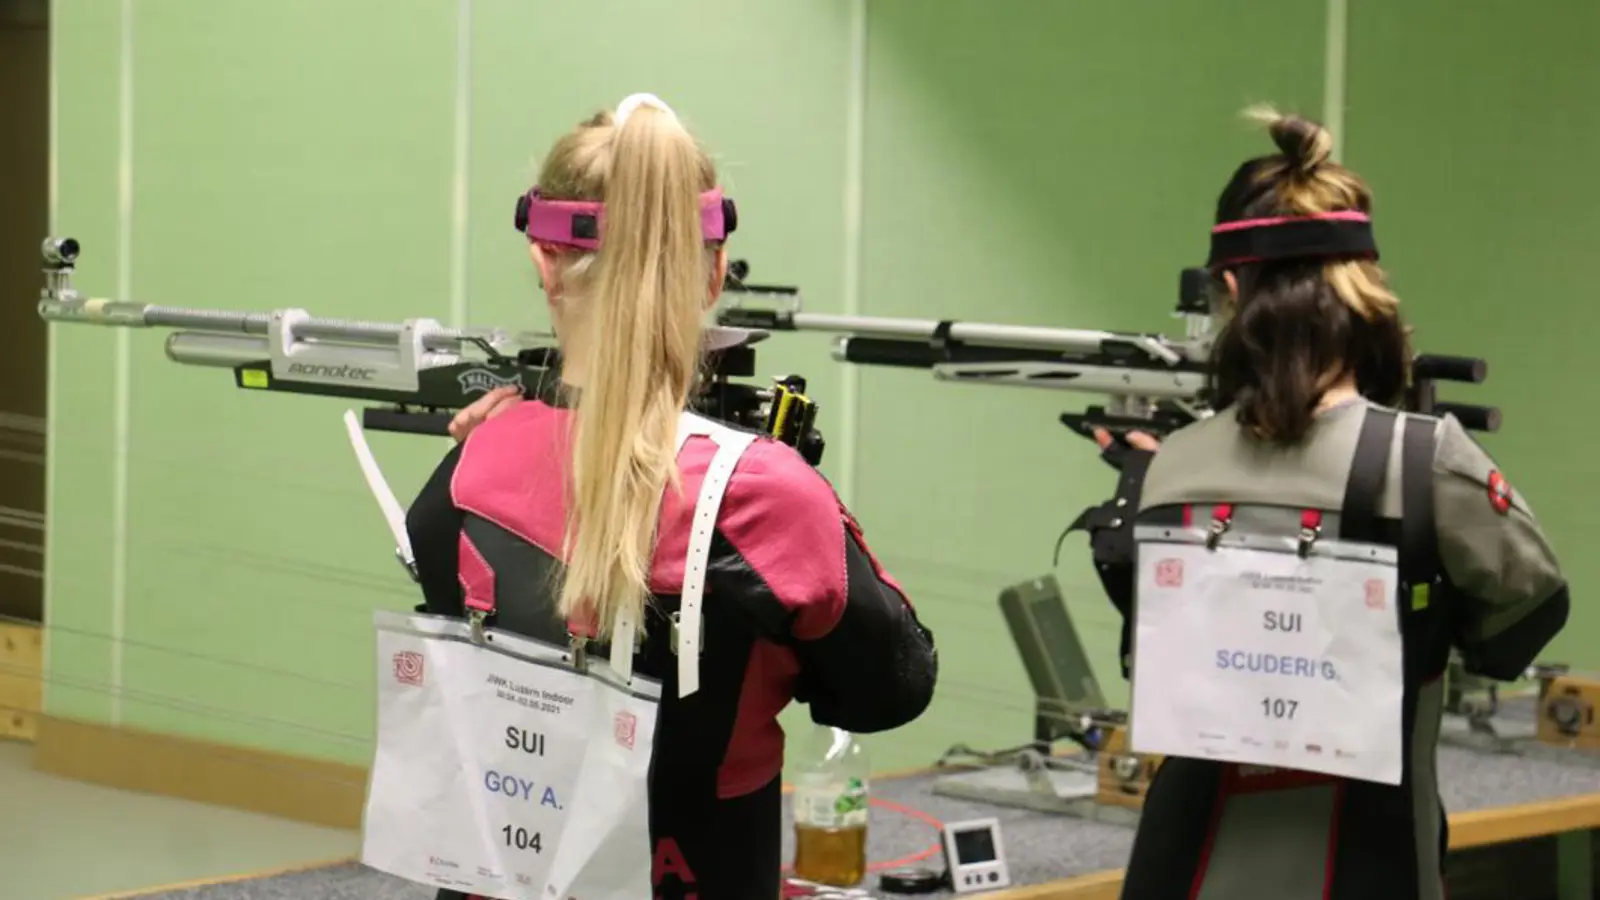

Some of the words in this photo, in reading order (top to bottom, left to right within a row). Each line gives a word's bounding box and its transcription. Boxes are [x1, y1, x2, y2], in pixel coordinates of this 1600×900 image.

[1263, 610, 1303, 632] SUI
[1216, 649, 1316, 677] SCUDERI
[1260, 697, 1299, 720] 107
[505, 726, 545, 756] SUI
[484, 770, 535, 801] GOY
[540, 786, 565, 811] A.
[502, 824, 543, 853] 104
